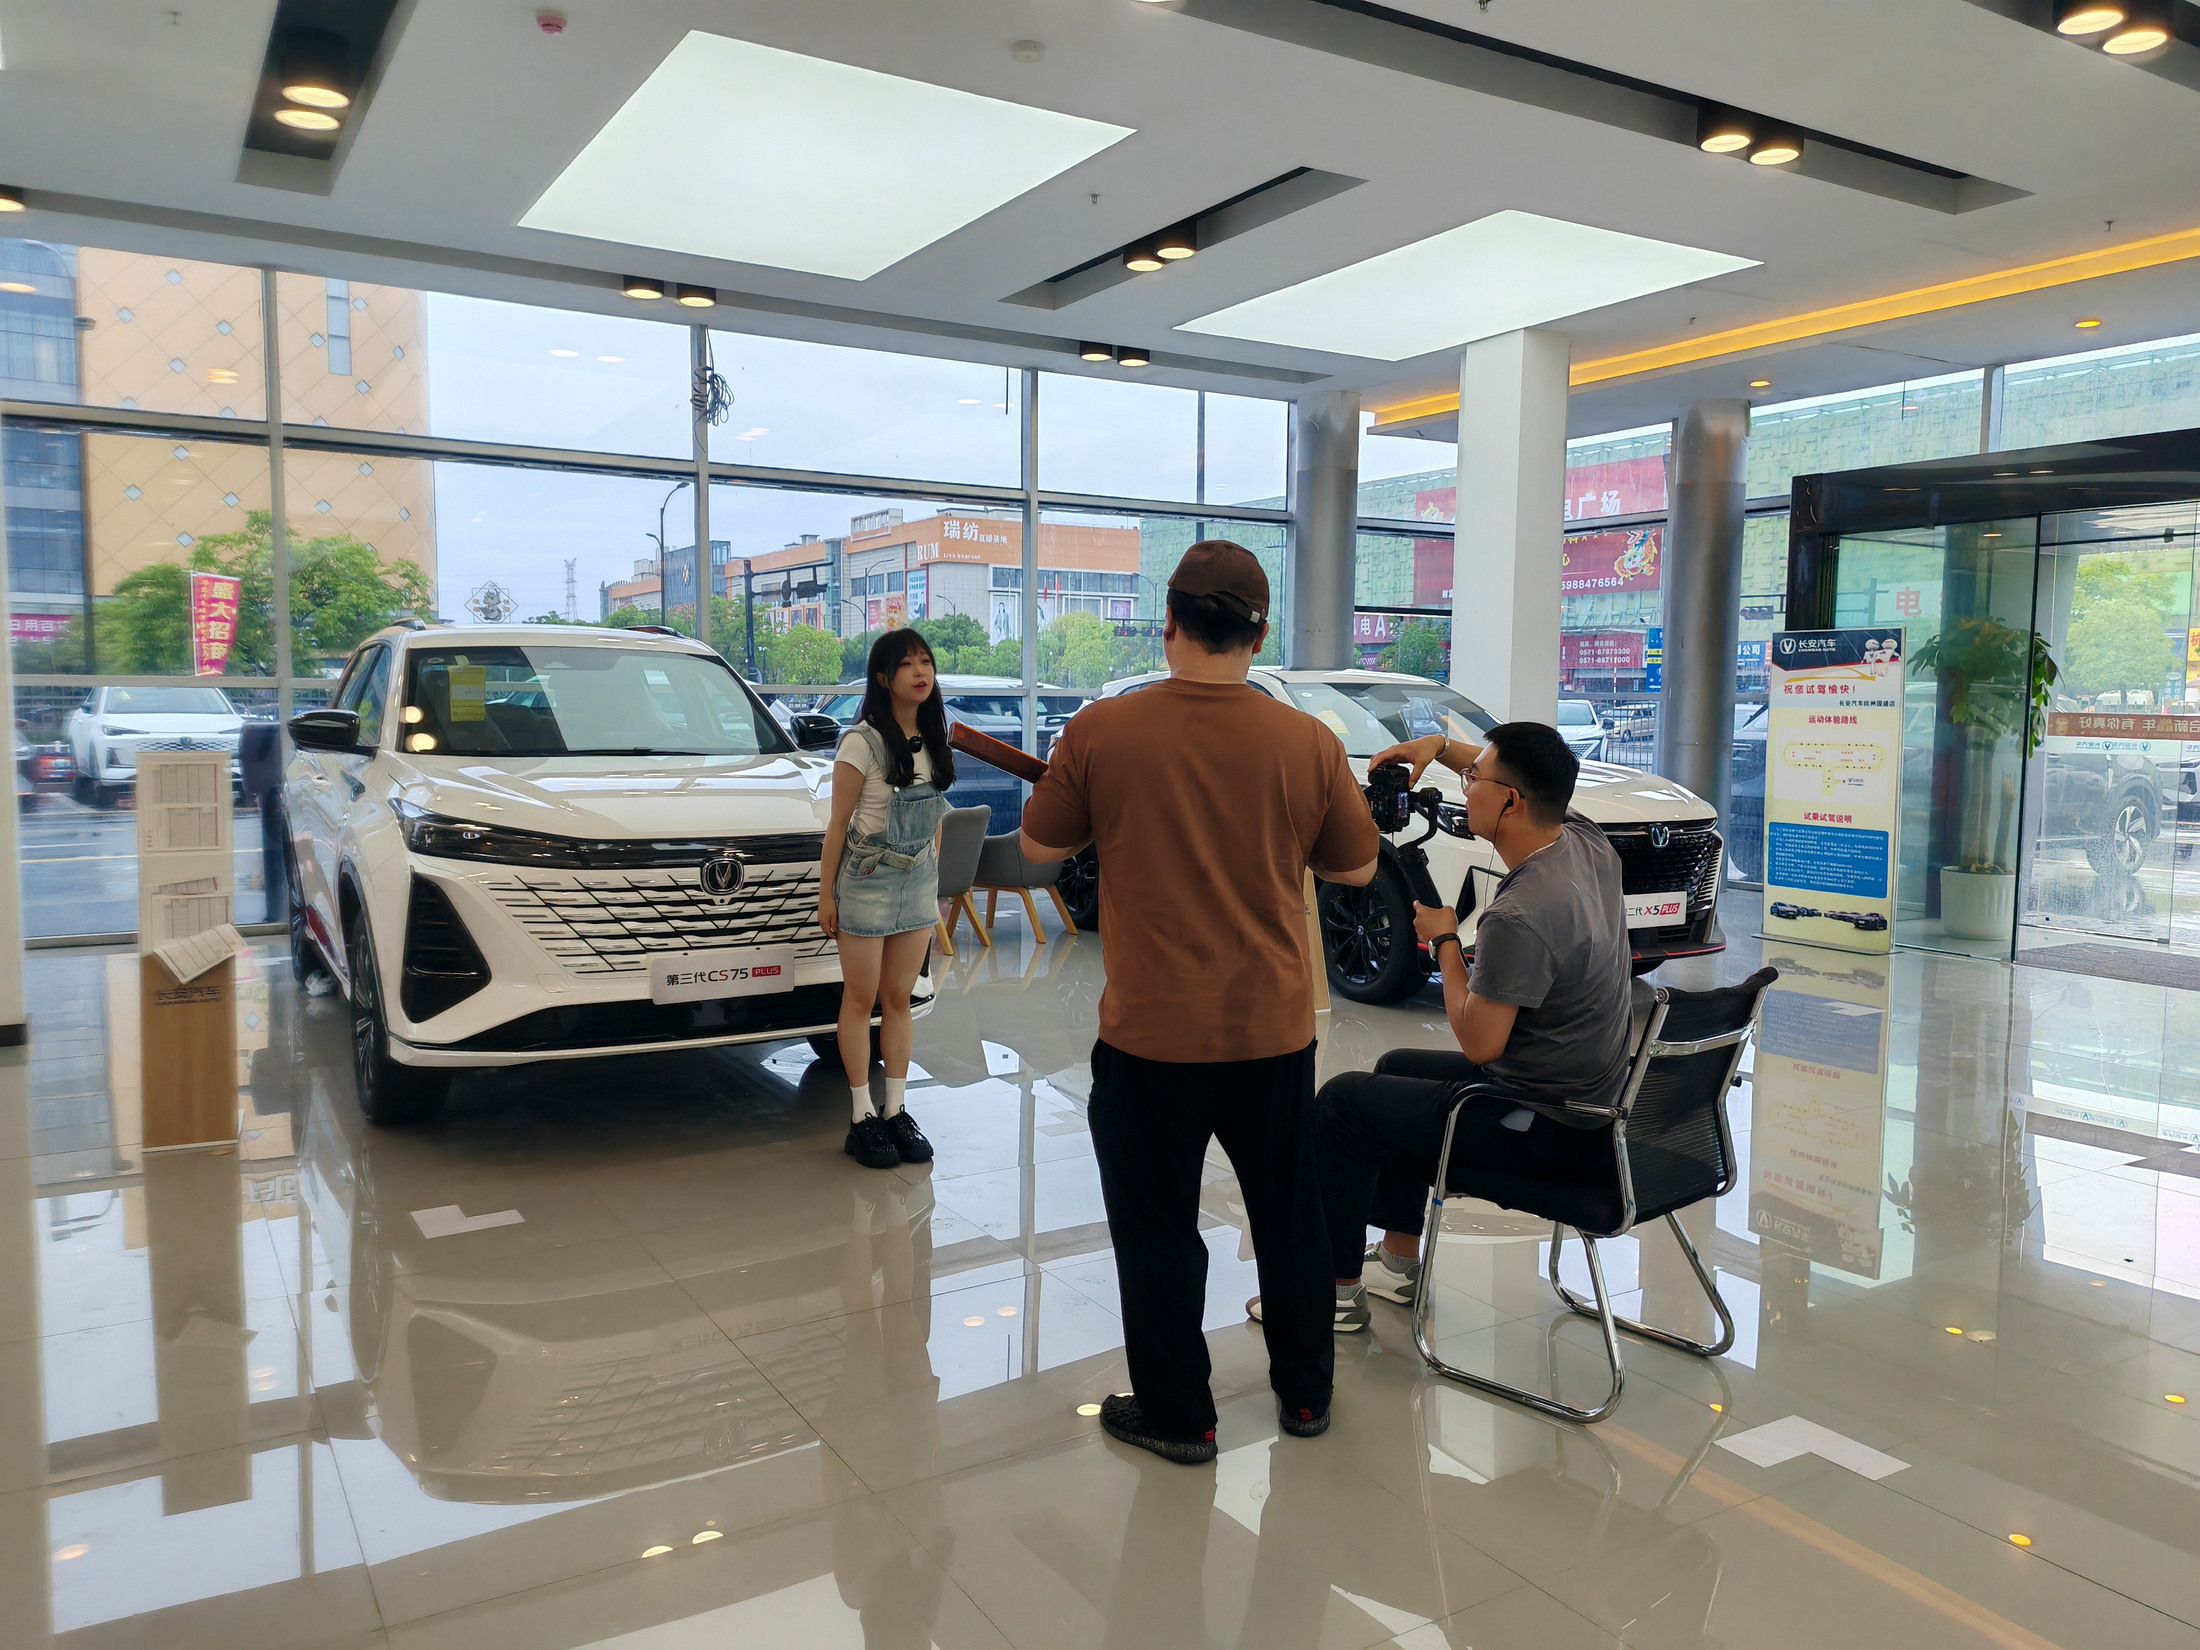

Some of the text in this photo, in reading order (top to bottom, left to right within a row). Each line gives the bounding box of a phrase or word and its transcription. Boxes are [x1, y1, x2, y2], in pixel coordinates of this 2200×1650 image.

[943, 519, 979, 542] 瑞纺
[917, 542, 940, 561] RUM
[209, 581, 234, 661] 盛大招商
[1798, 639, 1837, 649] 长安汽车
[1808, 715, 1858, 725] 运动体验路线
[1803, 812, 1853, 824] 试乘试驾说明
[1661, 904, 1680, 914] PLUS
[666, 967, 779, 986] 第三代CS75 PLUS
